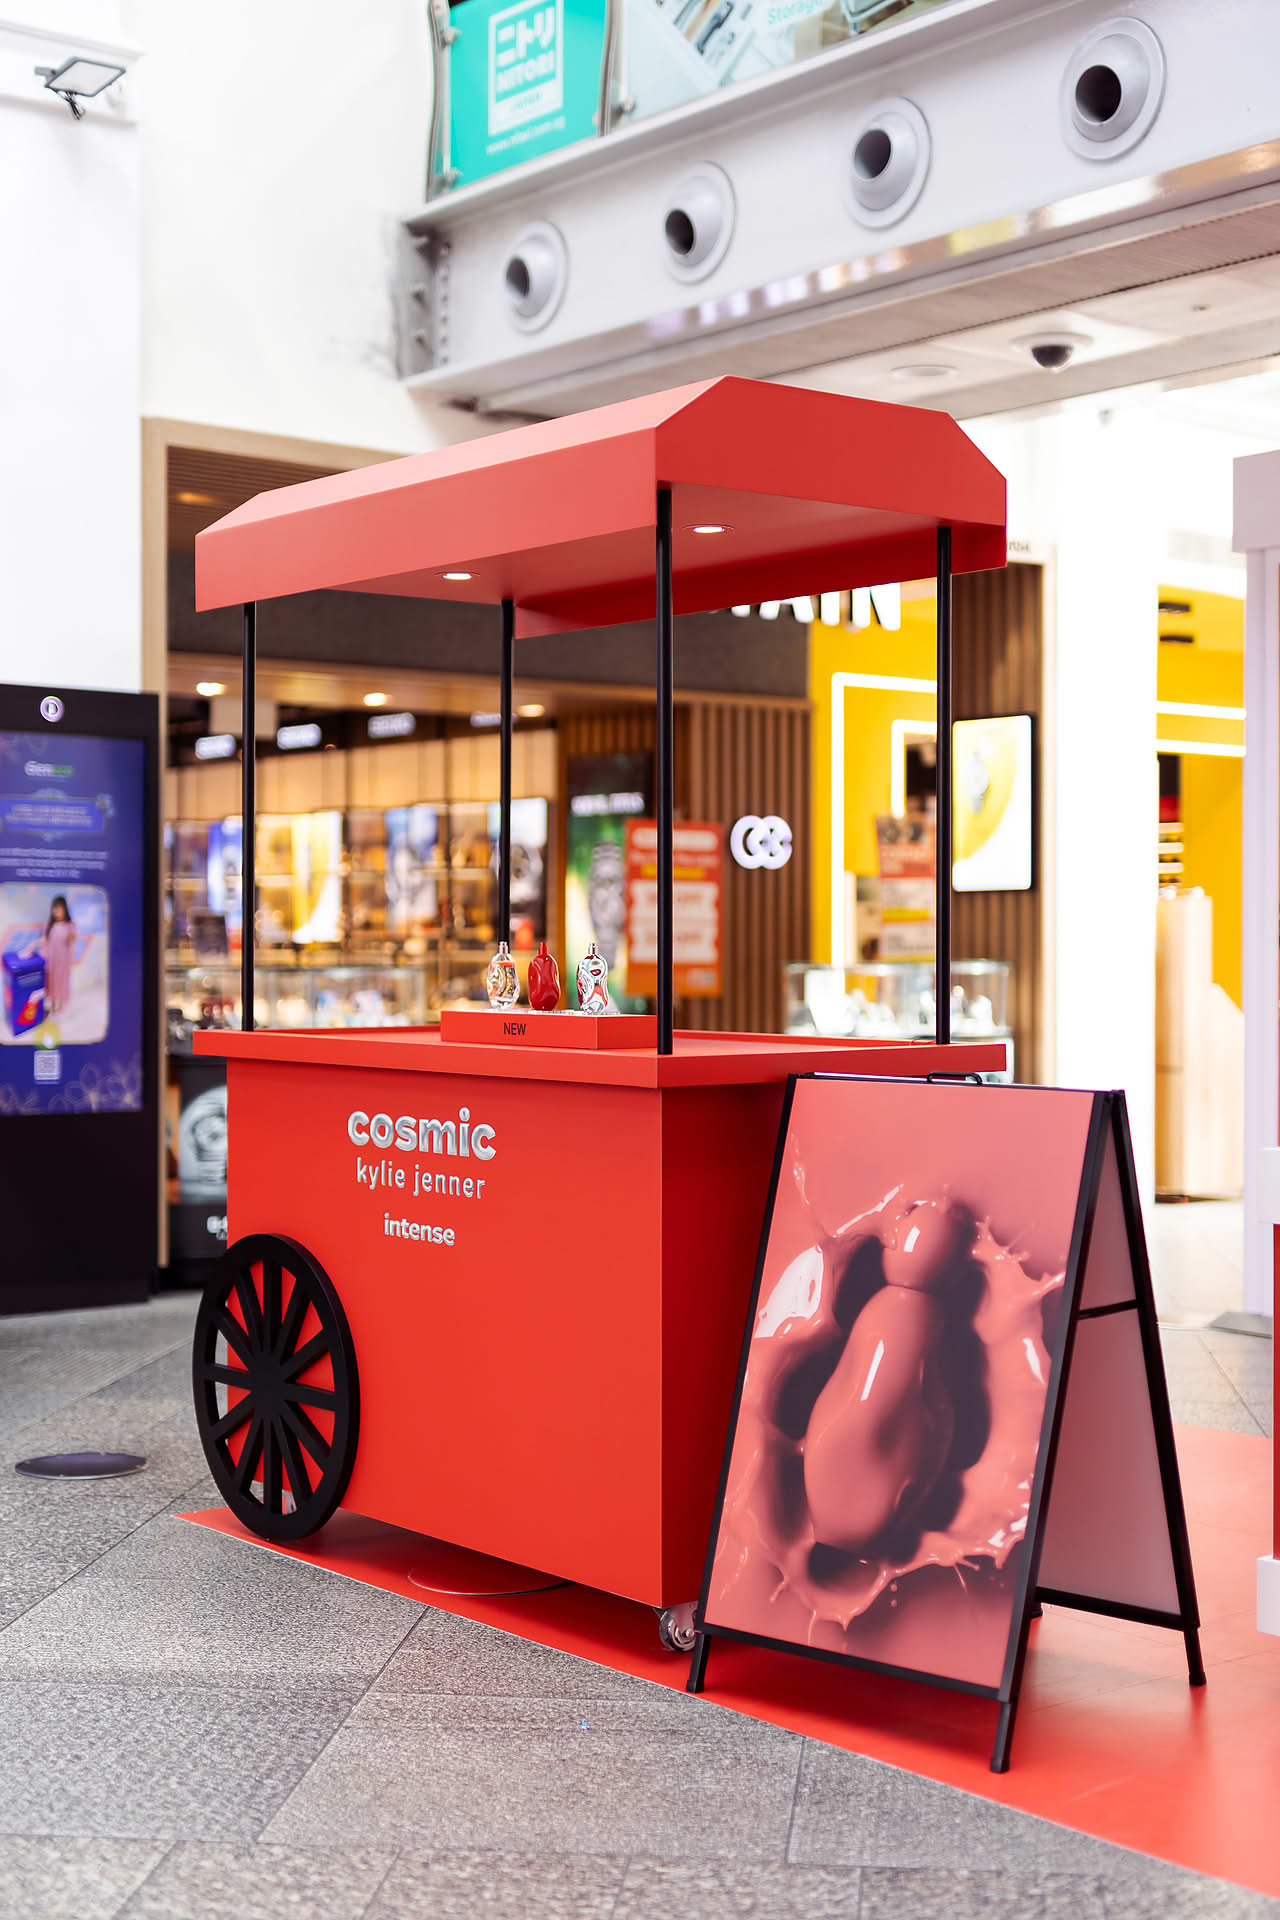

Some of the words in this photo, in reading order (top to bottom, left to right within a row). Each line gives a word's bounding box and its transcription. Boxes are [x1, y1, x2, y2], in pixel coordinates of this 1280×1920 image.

[503, 1022, 527, 1036] NEW
[347, 1107, 497, 1161] cosmic
[356, 1156, 406, 1191] kylie
[413, 1164, 486, 1199] jenner
[383, 1212, 456, 1247] intense
